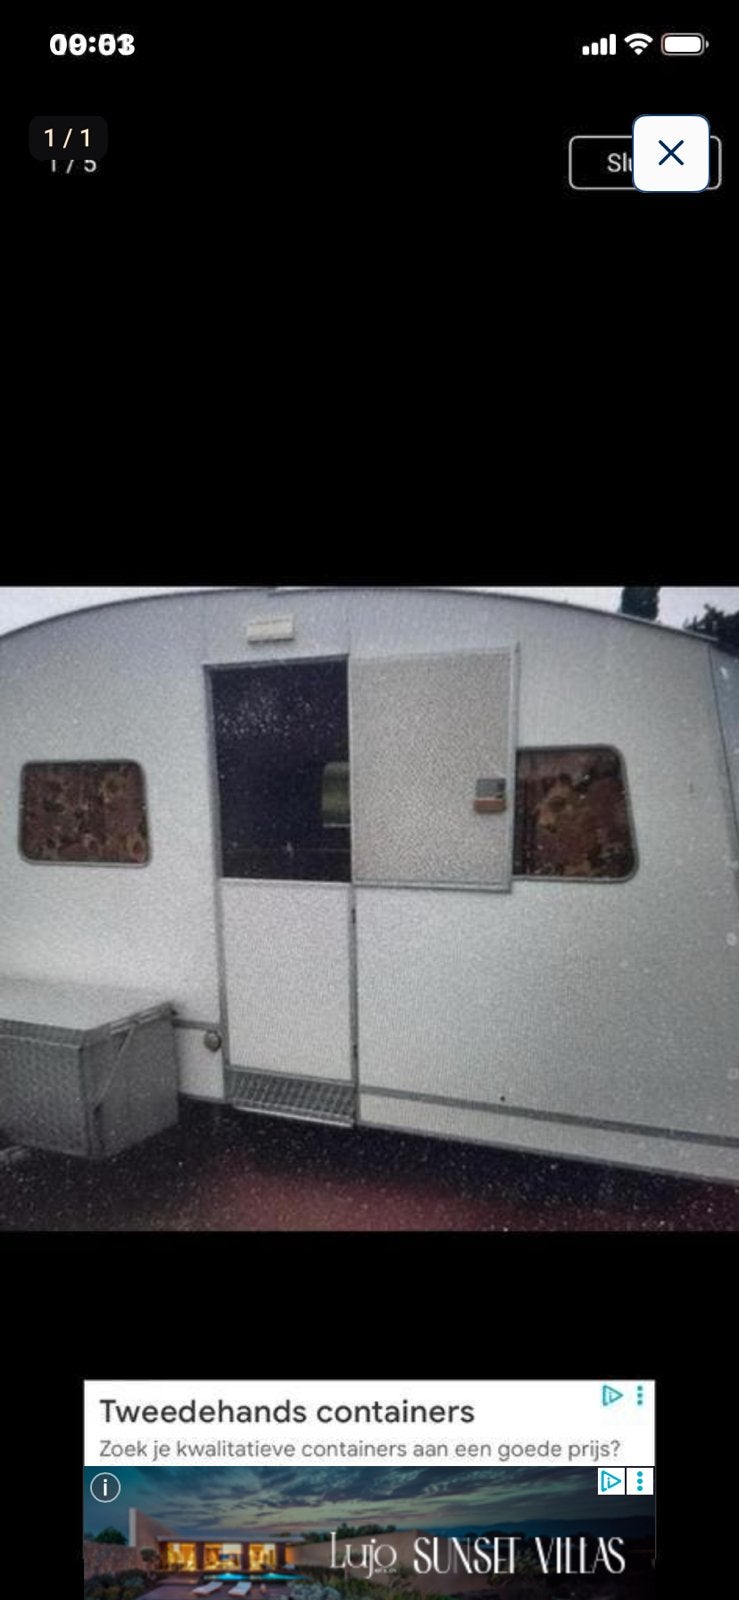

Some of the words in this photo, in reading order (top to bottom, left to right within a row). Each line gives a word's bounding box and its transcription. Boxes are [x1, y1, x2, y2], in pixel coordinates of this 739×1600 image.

[99, 1399, 308, 1424] Tweedehands
[316, 1399, 475, 1424] containers
[99, 1440, 148, 1458] Zoek
[152, 1440, 171, 1462] je
[176, 1439, 296, 1458] kwalitatieve
[301, 1440, 408, 1458] containers
[412, 1444, 448, 1458] aan
[455, 1444, 492, 1458] een
[498, 1440, 562, 1462] goede
[568, 1440, 621, 1462] prijs?
[330, 1531, 397, 1579] Lujo
[413, 1536, 522, 1574] SUNSET
[535, 1536, 626, 1574] VILLAS
